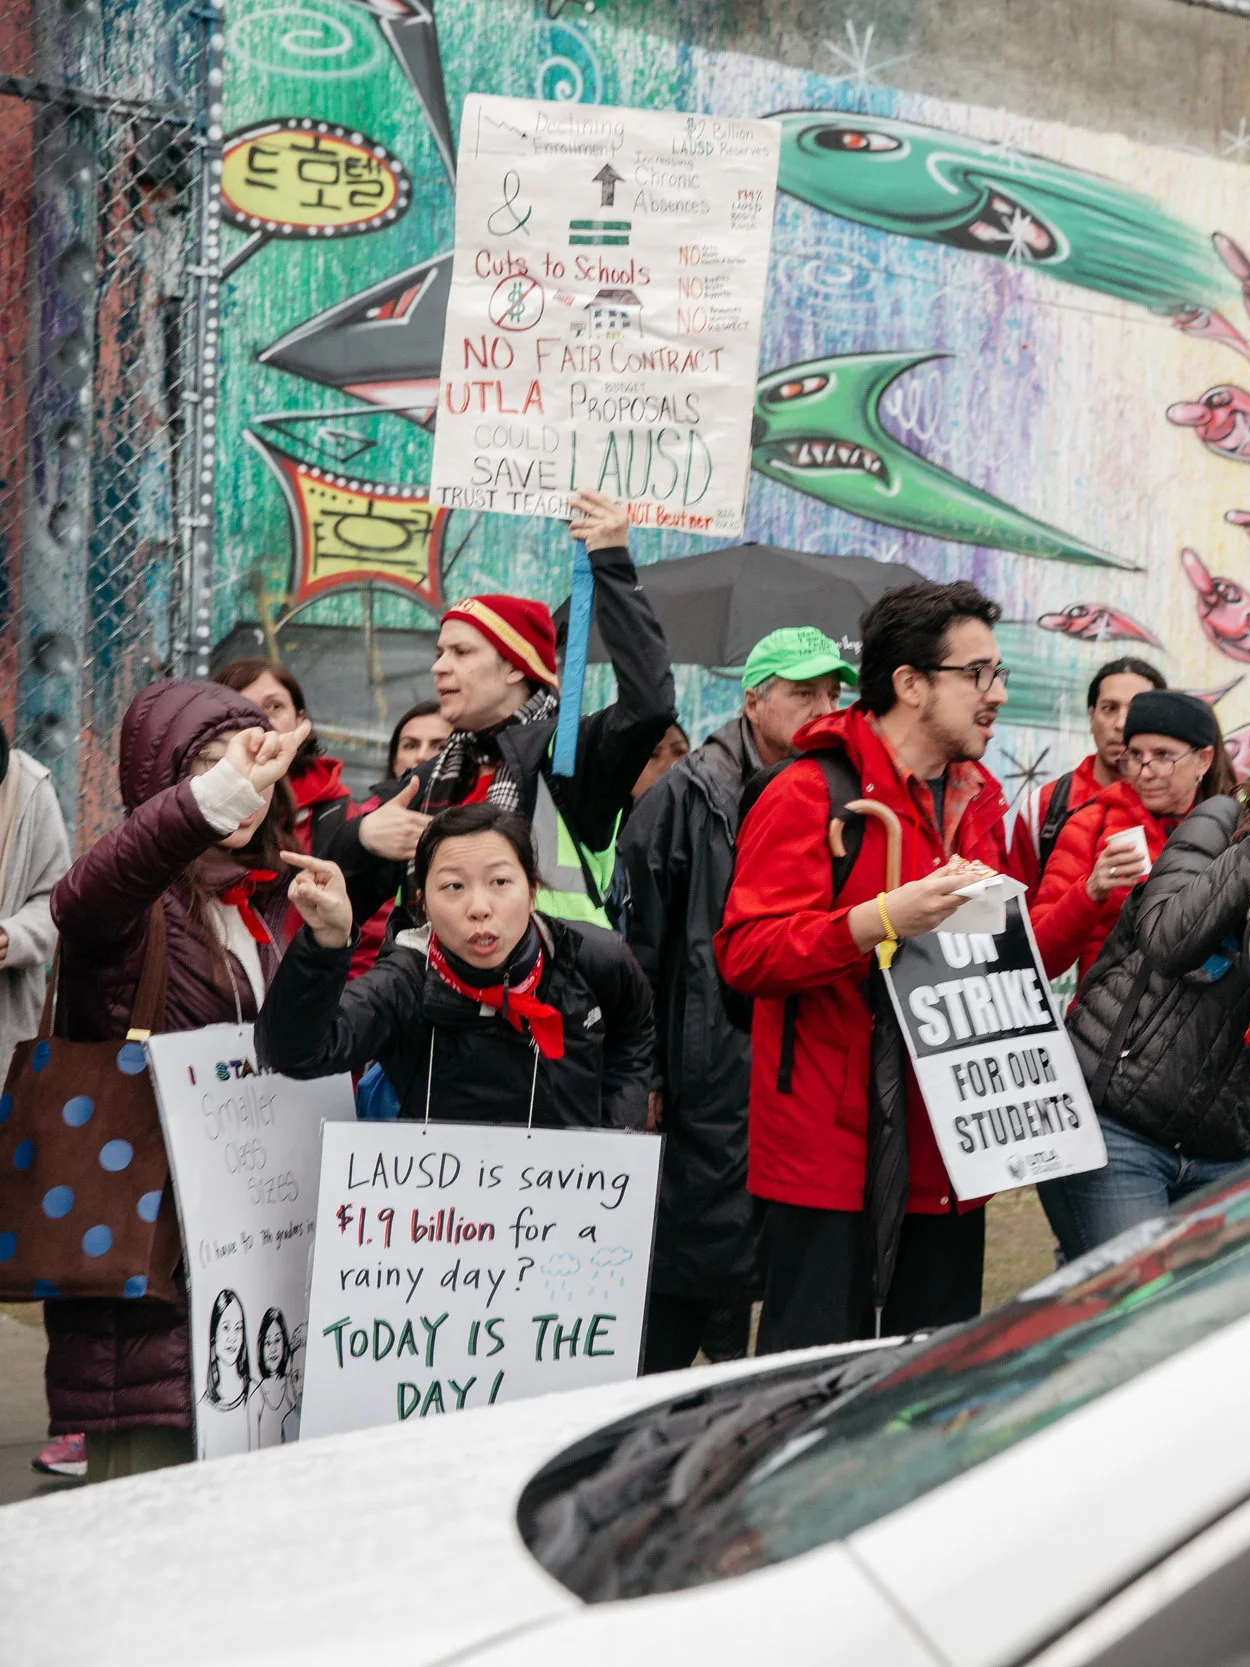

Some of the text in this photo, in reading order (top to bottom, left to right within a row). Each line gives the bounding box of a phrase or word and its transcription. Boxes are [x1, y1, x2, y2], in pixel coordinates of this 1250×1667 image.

[534, 111, 625, 145] Declining
[712, 120, 755, 142] Billion
[671, 137, 713, 158] LAUSD
[634, 165, 701, 190] Chronic
[632, 189, 711, 215] Absences
[475, 248, 651, 286] Cuts to Schools
[678, 244, 701, 267] NO
[678, 276, 704, 300] NO
[676, 305, 708, 336] NO
[463, 335, 726, 374] NO FAIR CONTRACT
[445, 378, 701, 425] UTLA PROPOSALS
[473, 424, 560, 455] COULD
[470, 427, 713, 508] SAVE LAUSD
[437, 487, 499, 511] TRUST
[627, 501, 651, 526] NOT
[655, 505, 715, 531] Beutner
[908, 968, 1052, 1047] STRIKE
[187, 1065, 196, 1086] I
[952, 1047, 1058, 1101] FOR OUR
[201, 1085, 277, 1141] Smaller
[954, 1092, 1081, 1153] STUDENTS
[346, 1152, 631, 1210] LAUSD is saving
[335, 1204, 597, 1249] $1.9 billion for a
[339, 1263, 424, 1305] rainy
[322, 1313, 618, 1369] TODAY IS THE
